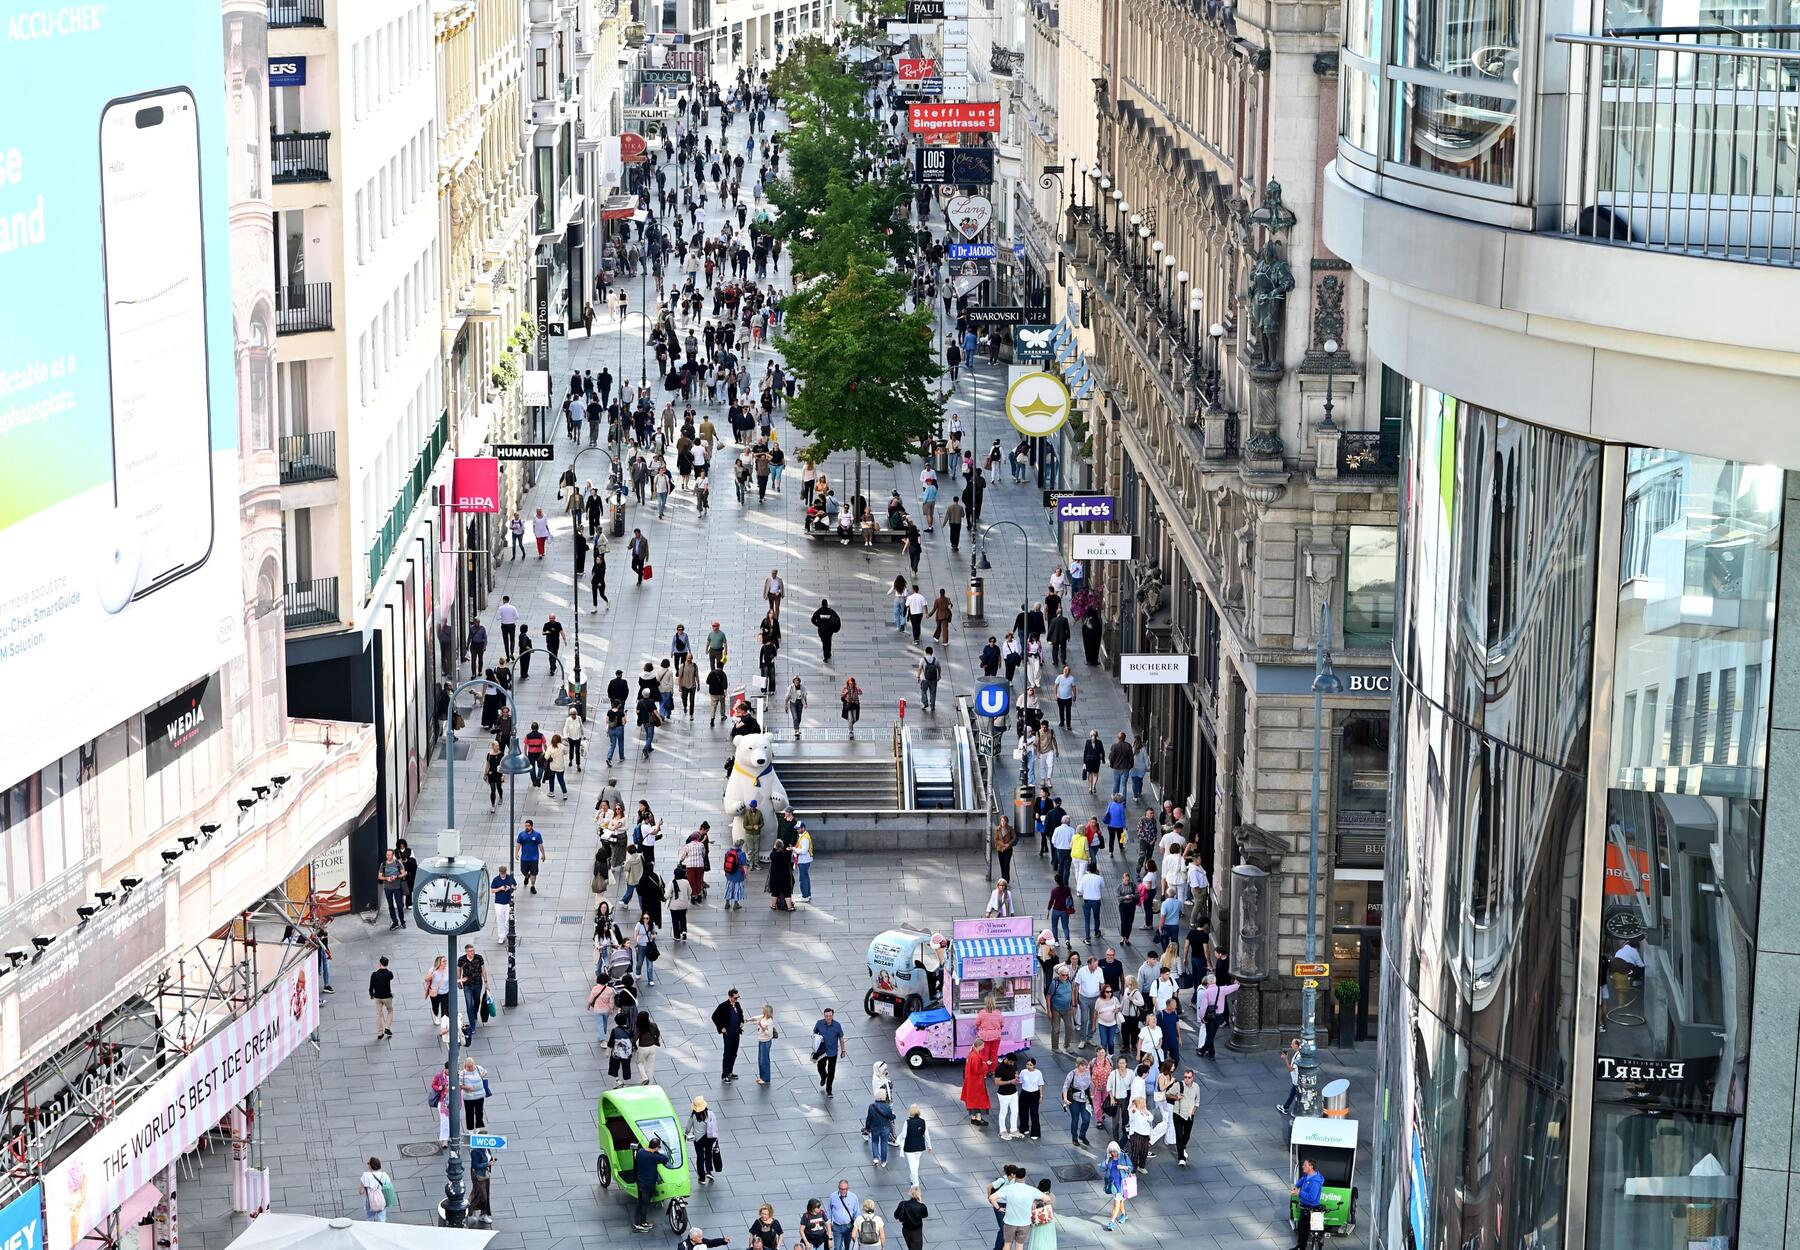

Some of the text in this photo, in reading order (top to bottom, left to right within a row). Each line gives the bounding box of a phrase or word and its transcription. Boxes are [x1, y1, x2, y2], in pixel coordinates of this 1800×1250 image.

[914, 4, 942, 13] PAUL
[645, 72, 687, 82] DOUGLAS
[641, 110, 668, 118] KLIMT
[913, 108, 995, 117] Steffl und
[913, 118, 995, 129] Singerstrasse 5
[923, 150, 945, 169] LOOS
[952, 198, 988, 219] Lanz
[958, 246, 996, 257] Dr JACOBS
[970, 312, 1019, 321] SWAROVSKI
[538, 300, 547, 361] Marc O'Polo
[497, 448, 549, 458] HUMANIC
[458, 497, 495, 510] BIPA
[1061, 502, 1110, 517] claire's
[1087, 548, 1117, 556] ROLEX
[33, 589, 81, 623] SmartGuide
[10, 631, 46, 658] Solution.
[1130, 663, 1179, 671] BUCHERER
[1349, 676, 1392, 691] BUC
[982, 690, 1004, 713] U
[312, 856, 344, 870] STORE
[874, 959, 894, 967] MOZART
[103, 1016, 281, 1181] THE WORLD'S BEST ICE CREAM
